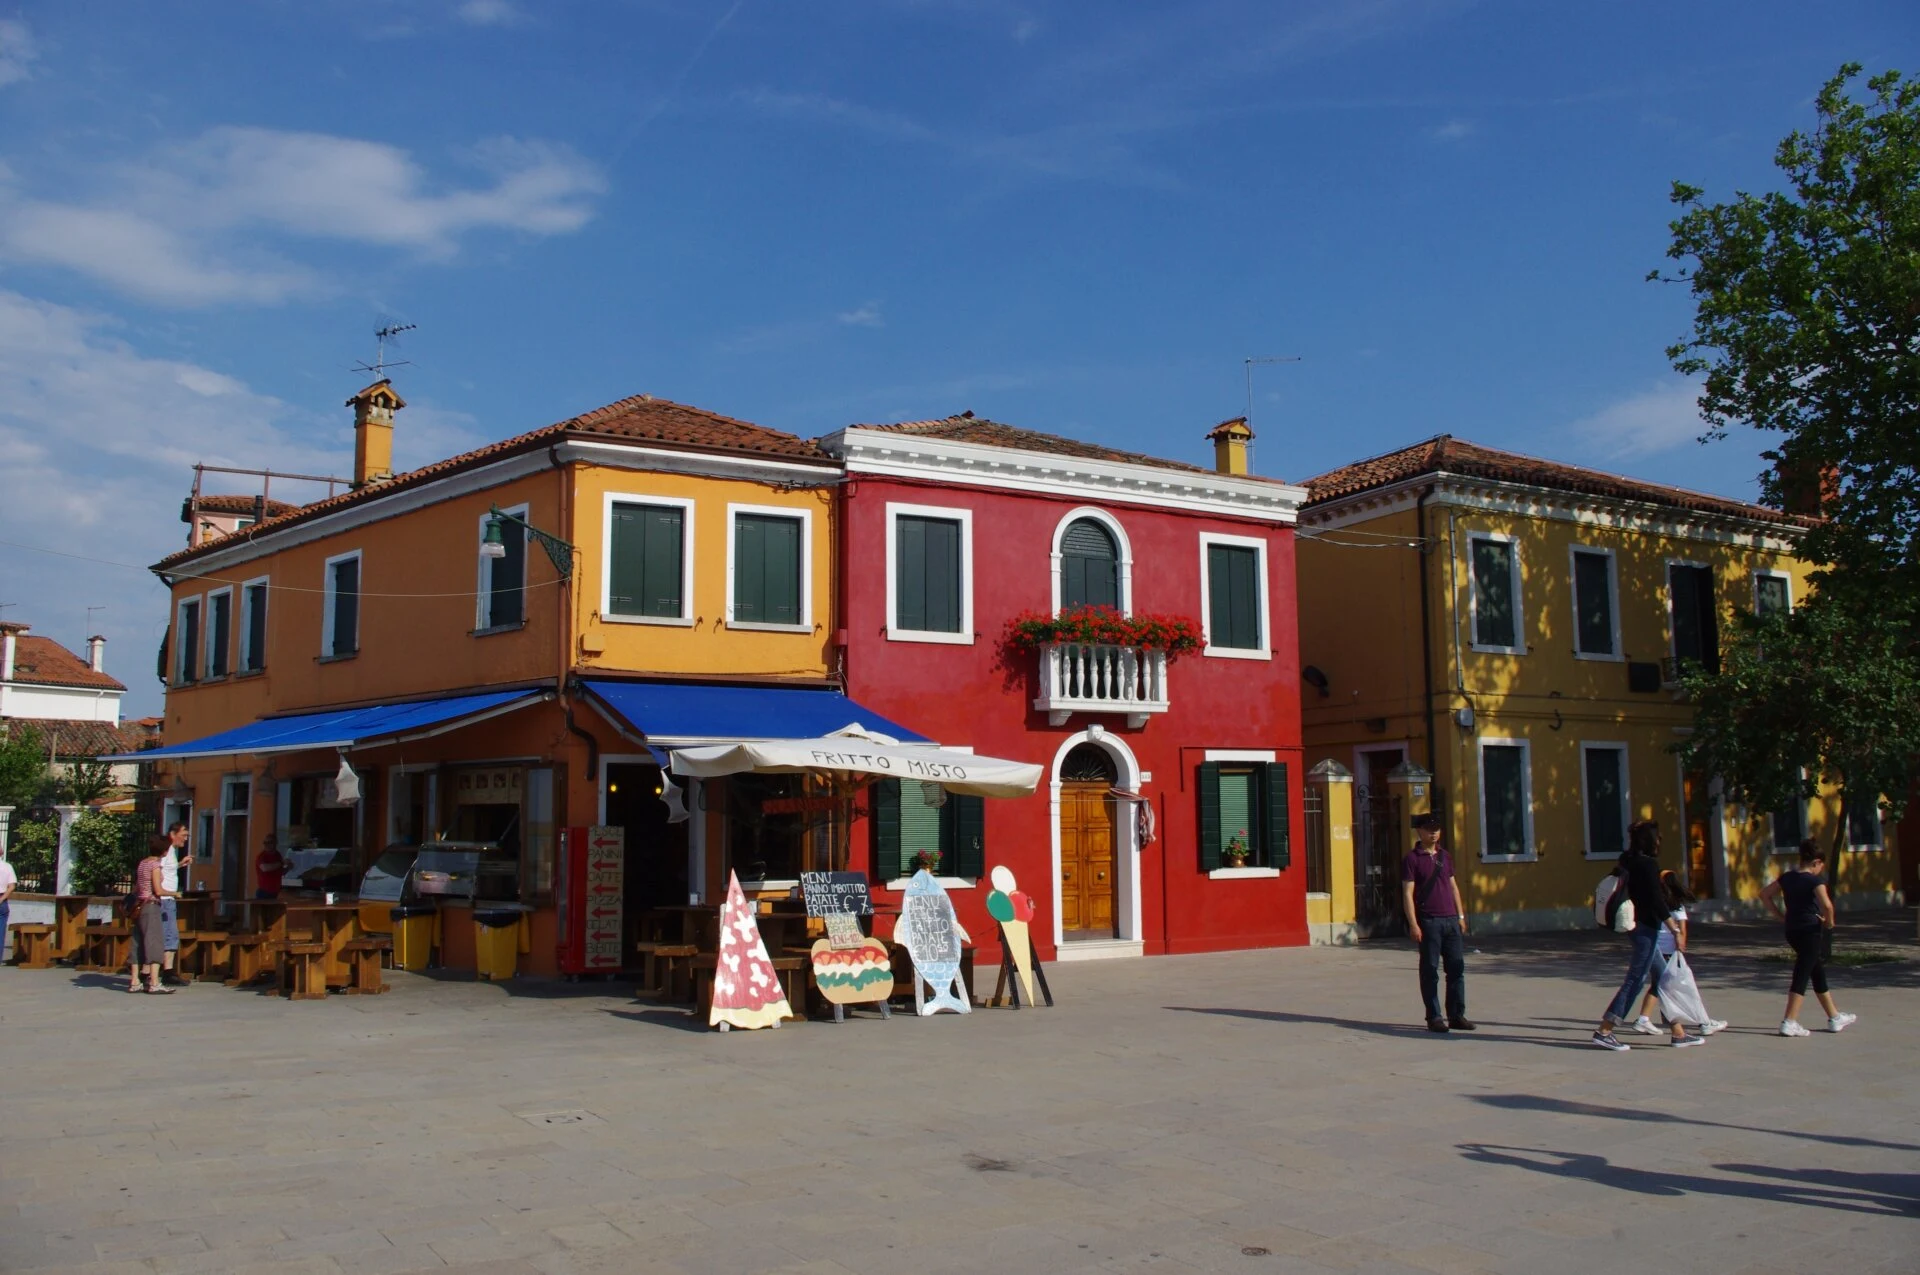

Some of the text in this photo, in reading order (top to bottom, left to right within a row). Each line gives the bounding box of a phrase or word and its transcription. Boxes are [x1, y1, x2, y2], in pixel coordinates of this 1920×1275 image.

[811, 750, 967, 779] FRITTO MISTO
[587, 848, 622, 859] PANINI
[803, 883, 866, 893] PANINO IMBOTTITO
[585, 895, 622, 906] PIZZA
[805, 894, 840, 905] PATATE
[905, 896, 940, 909] MENU
[806, 904, 841, 917] FRITTE
[910, 907, 941, 920] PESCE
[586, 919, 621, 930] GELATI
[910, 918, 949, 933] FRITTO
[911, 932, 949, 945] PATATE
[586, 942, 621, 953] BIBITE
